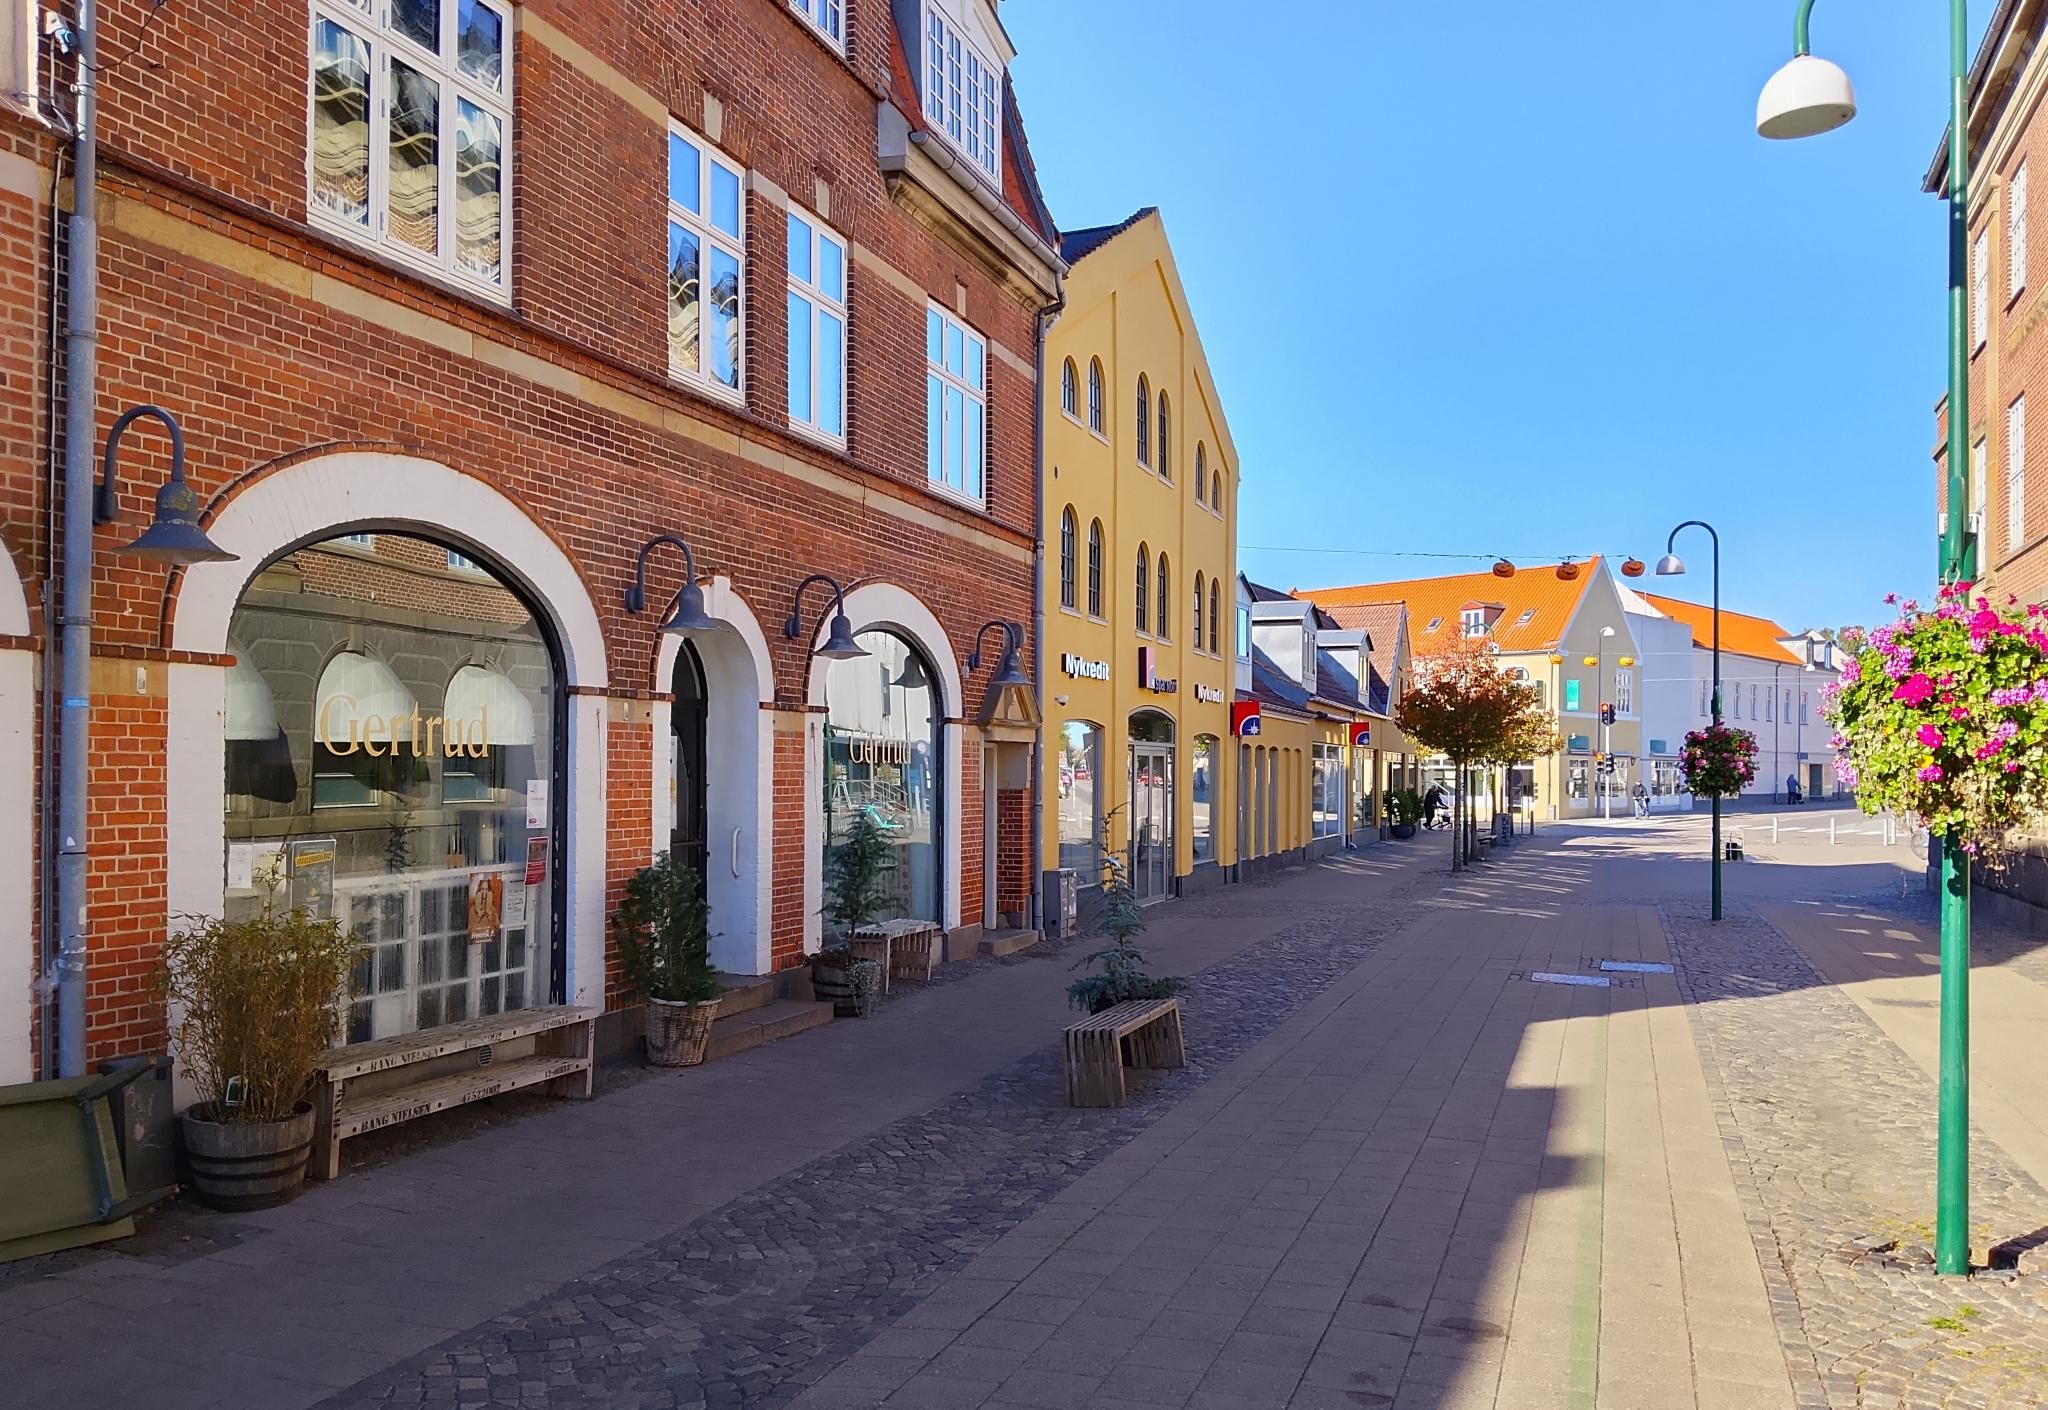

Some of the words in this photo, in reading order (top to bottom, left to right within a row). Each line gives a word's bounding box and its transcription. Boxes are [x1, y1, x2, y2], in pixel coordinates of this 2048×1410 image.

[1063, 652, 1110, 681] Nykredit
[1197, 684, 1224, 704] Nykredit
[320, 692, 489, 758] Gertrud
[849, 731, 912, 764] Gertrud
[361, 1115, 388, 1132] BANG
[391, 1102, 431, 1122] NIELSEN
